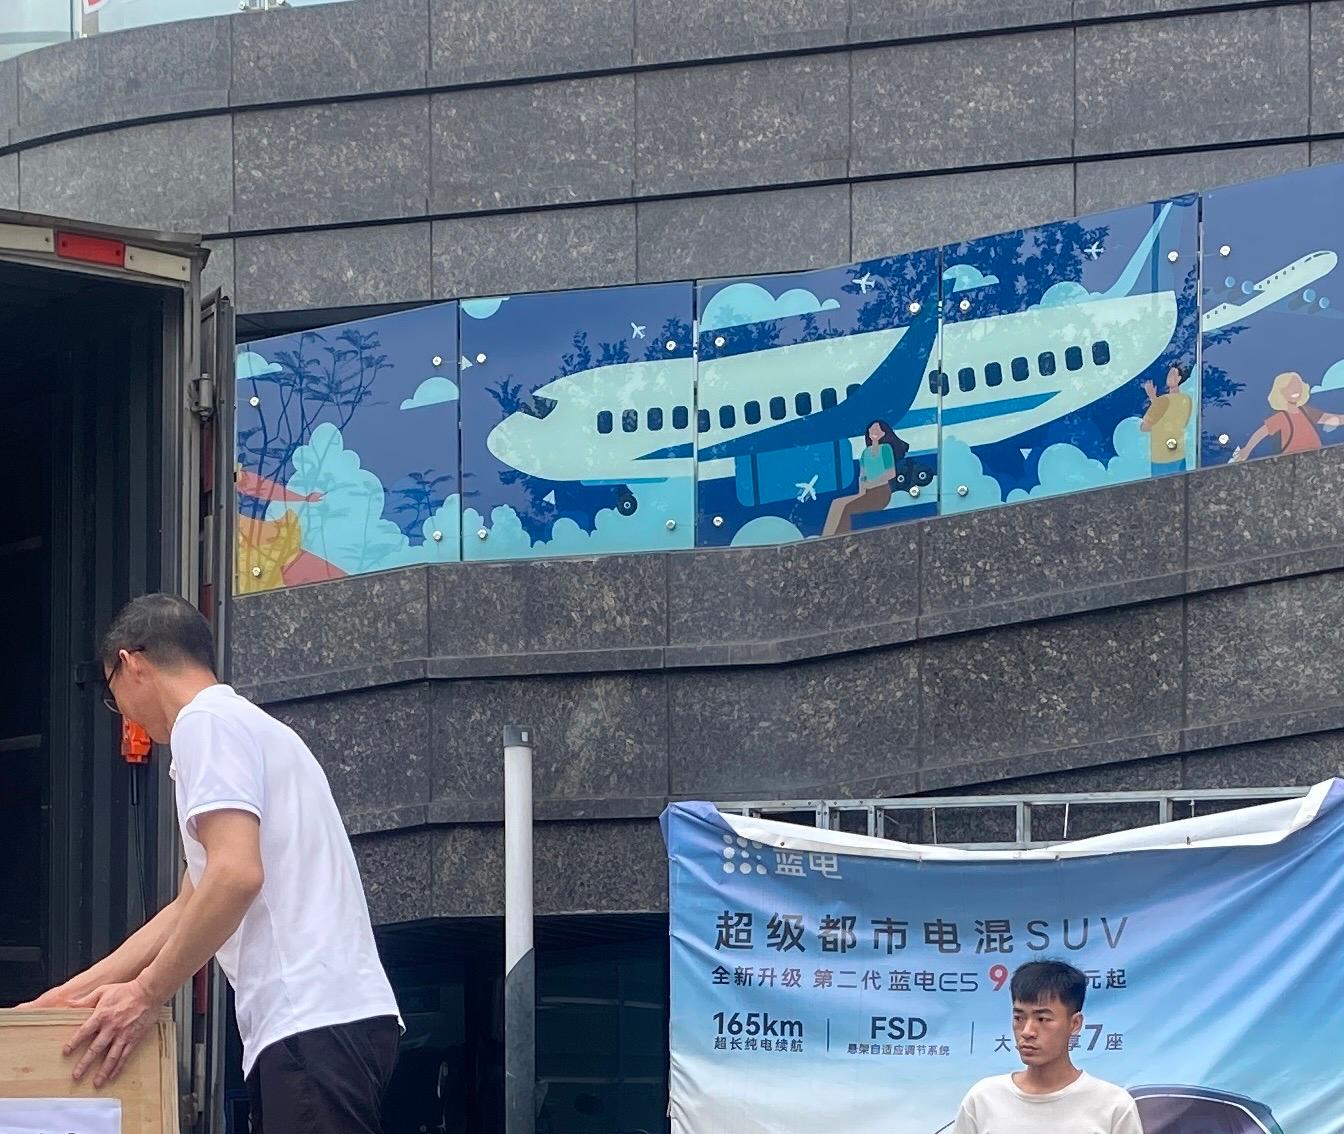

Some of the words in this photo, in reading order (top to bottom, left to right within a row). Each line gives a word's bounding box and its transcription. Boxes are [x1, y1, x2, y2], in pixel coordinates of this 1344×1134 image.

[774, 848, 843, 880] 蓝电
[714, 909, 1129, 955] 超级都市电混SUV
[711, 965, 802, 989] 全新升级
[814, 967, 882, 991] 第二代
[712, 1011, 804, 1037] 165km
[870, 1016, 928, 1040] FSD
[713, 1036, 804, 1053] 超长纯电续航
